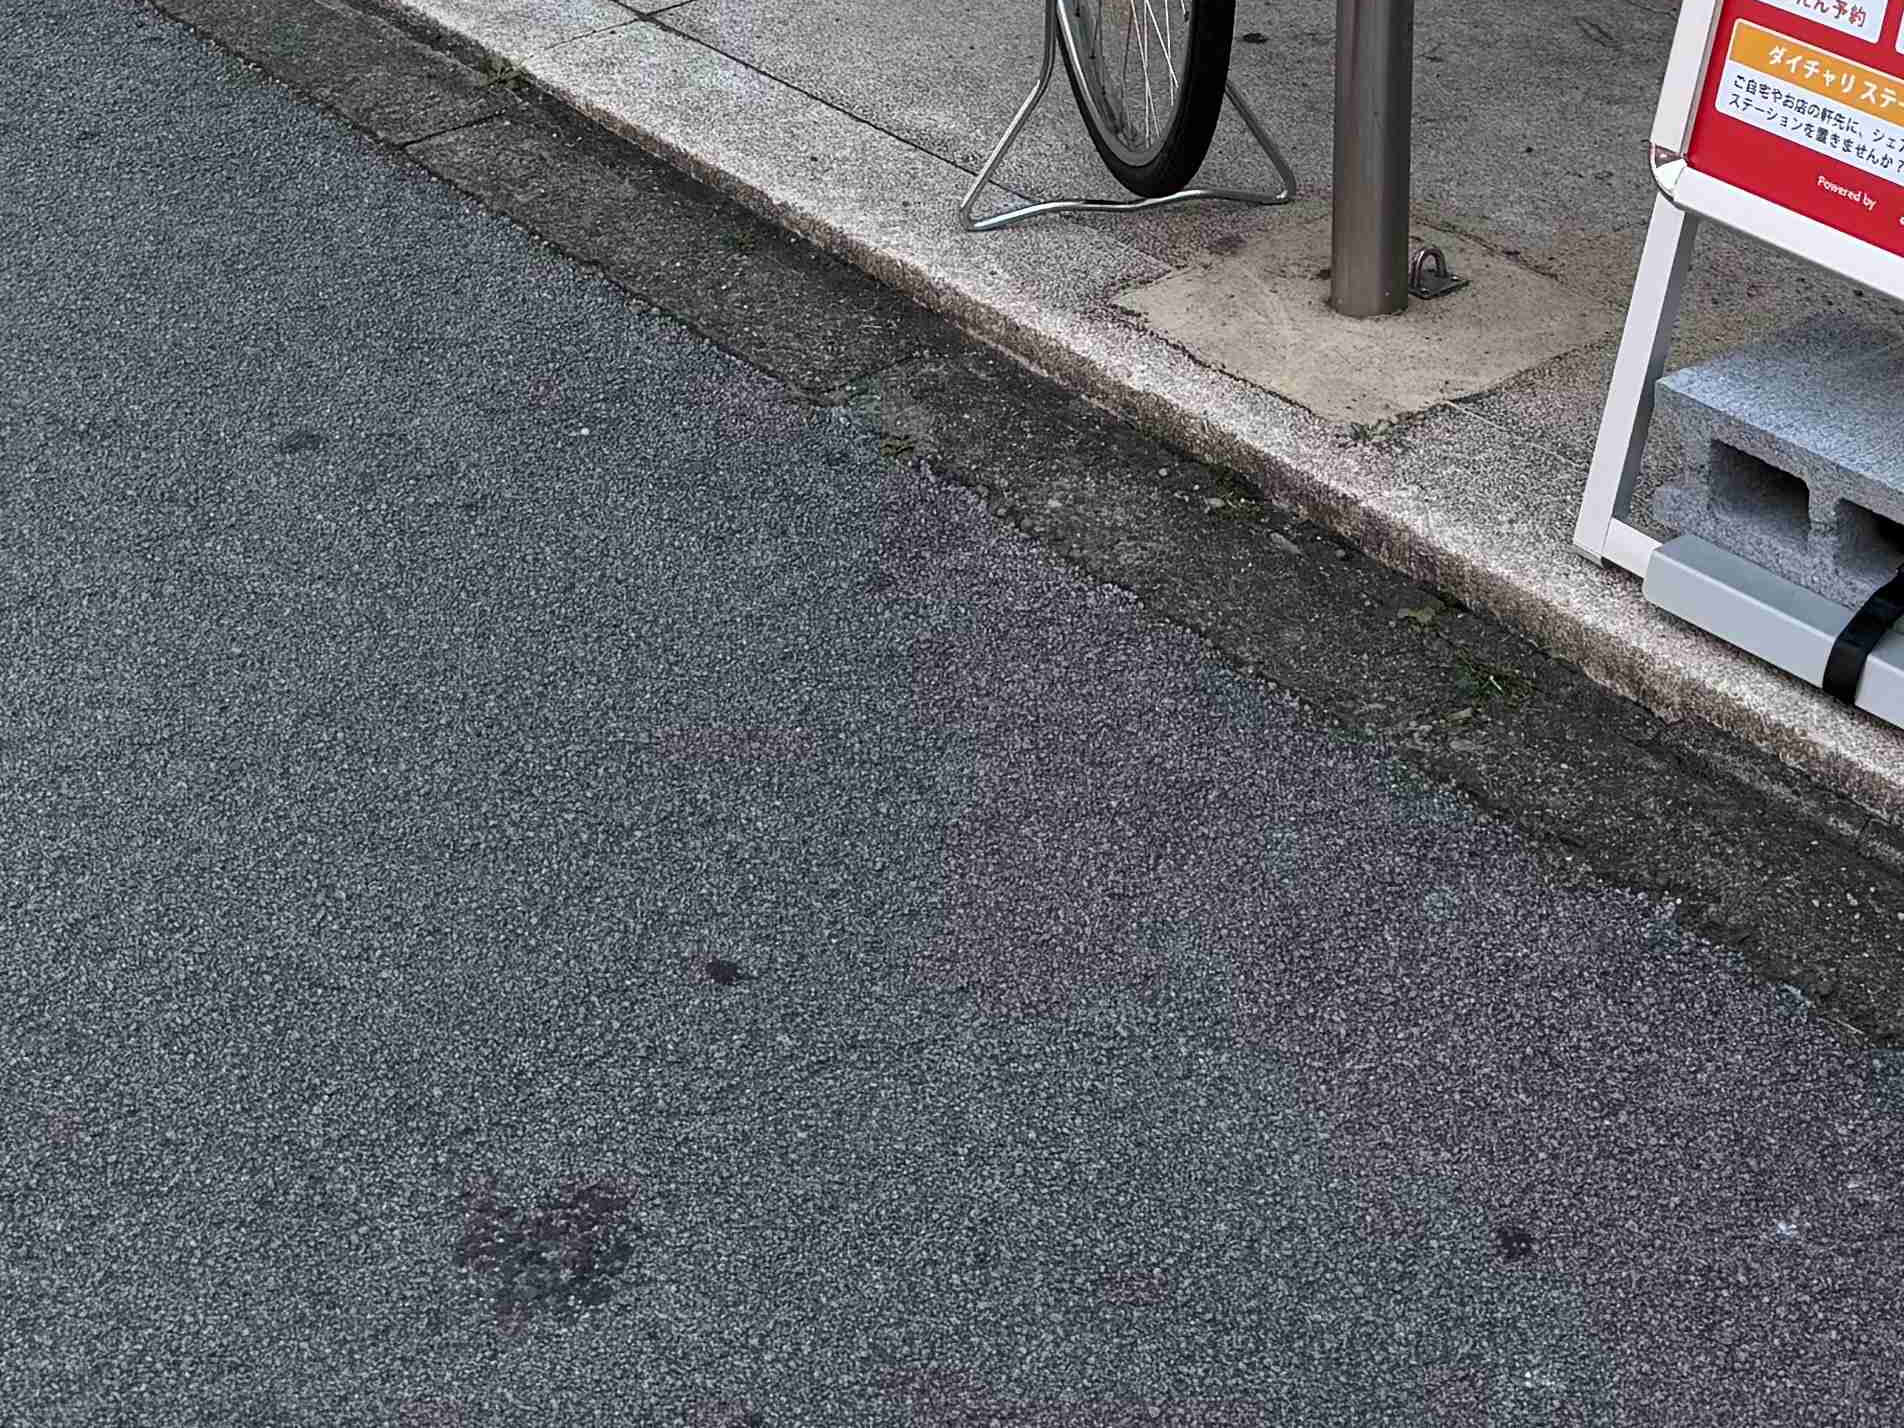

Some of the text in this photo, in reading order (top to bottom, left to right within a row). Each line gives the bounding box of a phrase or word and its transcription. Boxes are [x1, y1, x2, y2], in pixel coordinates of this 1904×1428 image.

[1767, 44, 1858, 94] ダイチャリ
[1817, 175, 1879, 211] Powered by
